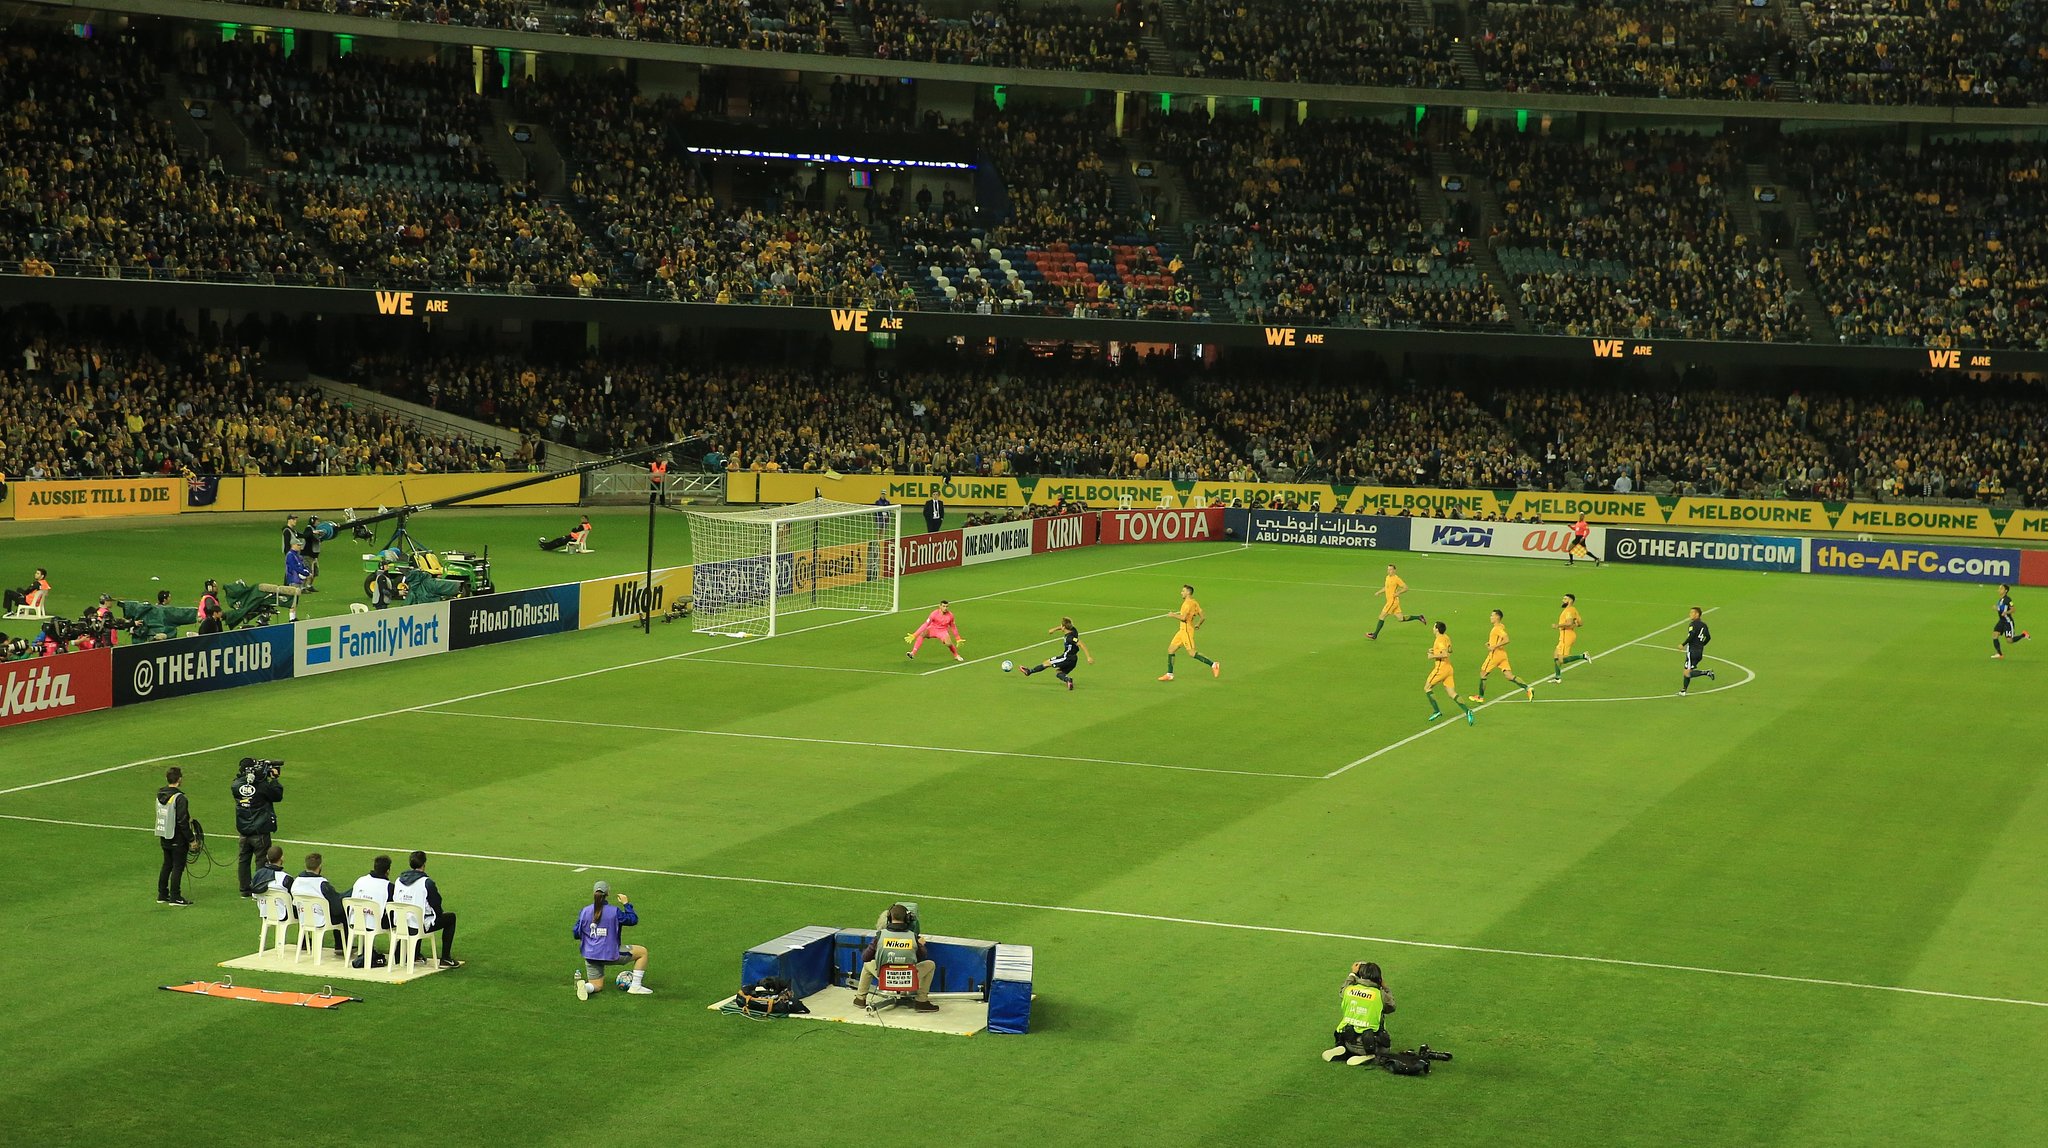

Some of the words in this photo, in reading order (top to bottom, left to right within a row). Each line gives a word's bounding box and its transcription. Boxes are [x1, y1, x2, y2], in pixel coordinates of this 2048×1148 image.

[376, 291, 413, 315] WE
[426, 300, 449, 312] ARE
[831, 309, 868, 332] WE
[880, 317, 903, 329] ARE
[1265, 327, 1296, 346] WE
[1304, 334, 1324, 344] ARE
[1593, 339, 1624, 358] WE
[1633, 345, 1652, 355] ARE
[1929, 350, 1961, 369] WE
[1970, 356, 1991, 366] ARE
[28, 490, 88, 506] AUSSIE
[91, 488, 126, 504] TILL
[130, 488, 136, 502] I
[140, 487, 170, 502] DIE
[889, 482, 1007, 499] MELBOURNE
[1047, 485, 1163, 502] MELBOURNE
[1363, 494, 1484, 512] MELBOURNE
[1525, 499, 1646, 517] MELBOURNE
[1256, 513, 1318, 533] أبوظبي
[1689, 505, 1811, 523] MELBOURNE
[1852, 511, 1978, 530] MELBOURNE
[1046, 516, 1083, 550] KIRIN
[1115, 512, 1210, 541] TOYOTA
[1320, 518, 1378, 535] مطارات
[966, 535, 978, 557] ONE
[978, 533, 994, 555] ASIA
[1001, 531, 1014, 551] ONE
[1014, 528, 1029, 549] GOAL
[1255, 532, 1280, 543] ABU
[1282, 533, 1317, 545] DHABI
[1320, 535, 1377, 548] AIRPORTS
[1431, 525, 1494, 548] KDDI
[1522, 530, 1573, 553] au
[888, 542, 908, 575] Fy
[909, 536, 958, 568] Emirates
[1616, 538, 1796, 564] @THEAFCDOTCOM
[1817, 546, 2011, 576] the-AFC.com
[611, 581, 664, 618] Nikon
[339, 614, 439, 659] FamilyMart
[1697, 627, 1705, 642] 4
[134, 641, 272, 696] @THEAFCHUB
[0, 666, 76, 717] kita
[885, 941, 910, 949] Nikon
[1350, 989, 1373, 1000] Nikon
